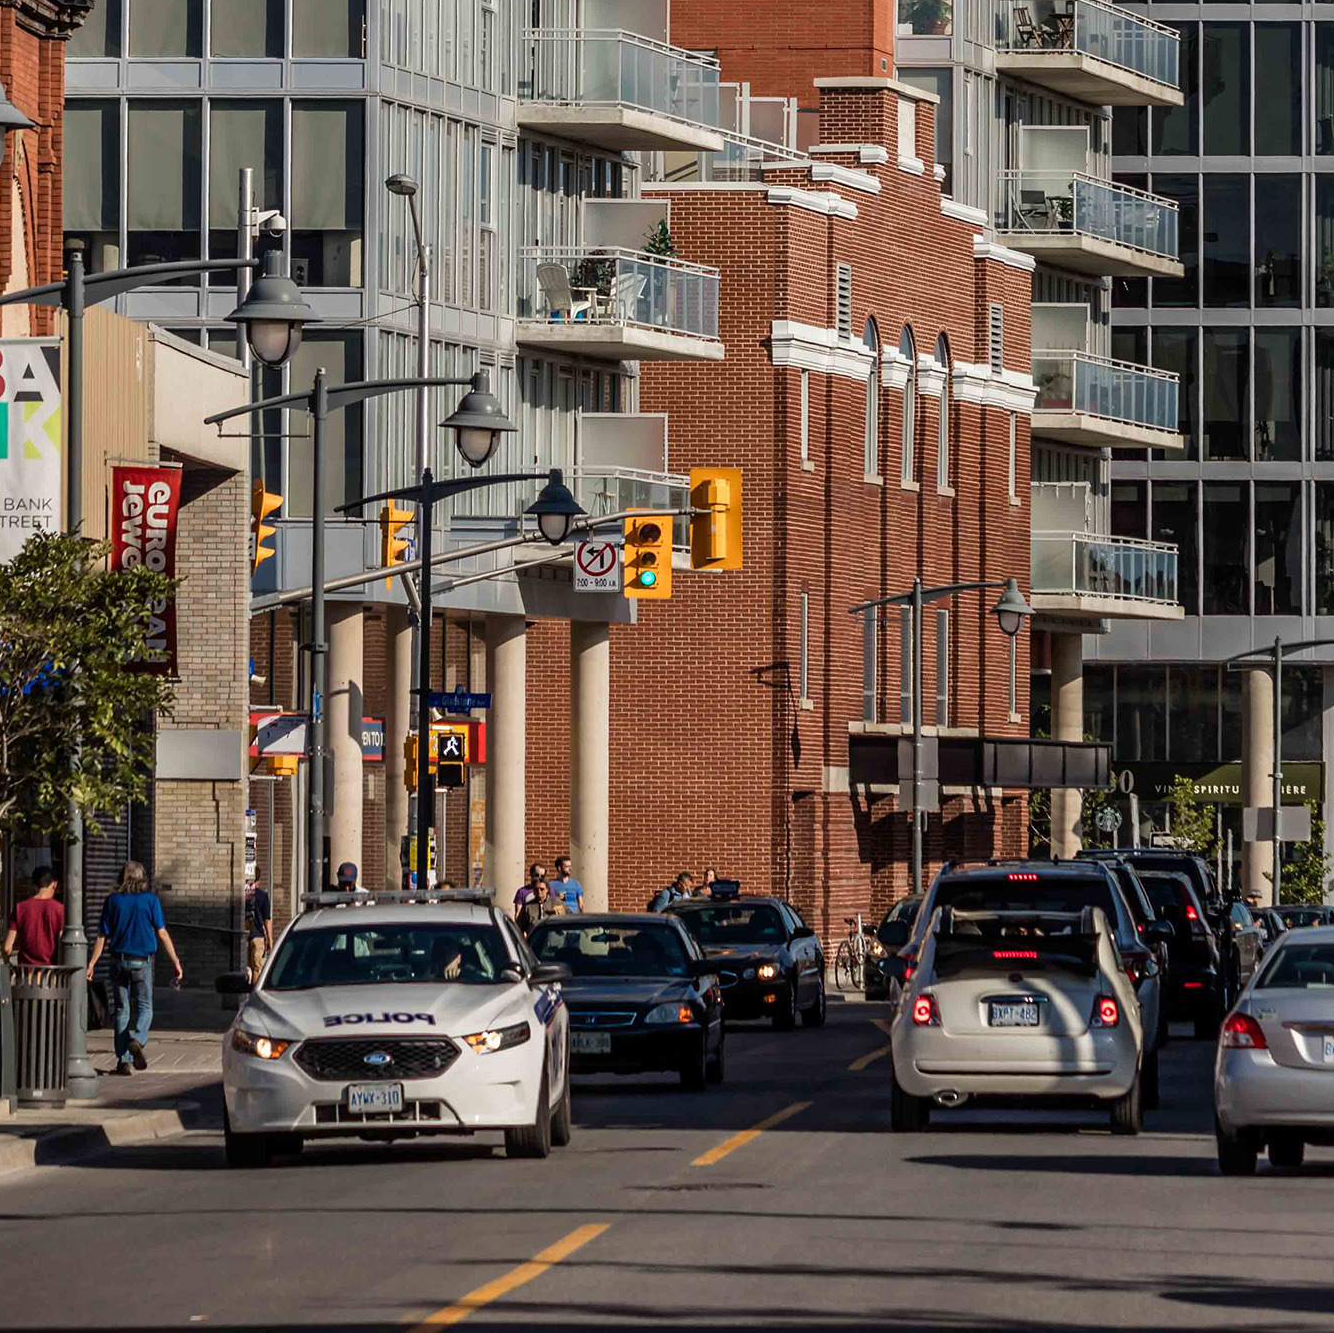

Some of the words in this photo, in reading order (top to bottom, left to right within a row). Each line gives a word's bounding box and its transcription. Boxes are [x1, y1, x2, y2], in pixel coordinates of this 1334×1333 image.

[3, 497, 53, 512] BANK
[441, 695, 476, 707] Gladstone
[1155, 784, 1181, 794] VIN
[1193, 784, 1240, 794] SPIRITU
